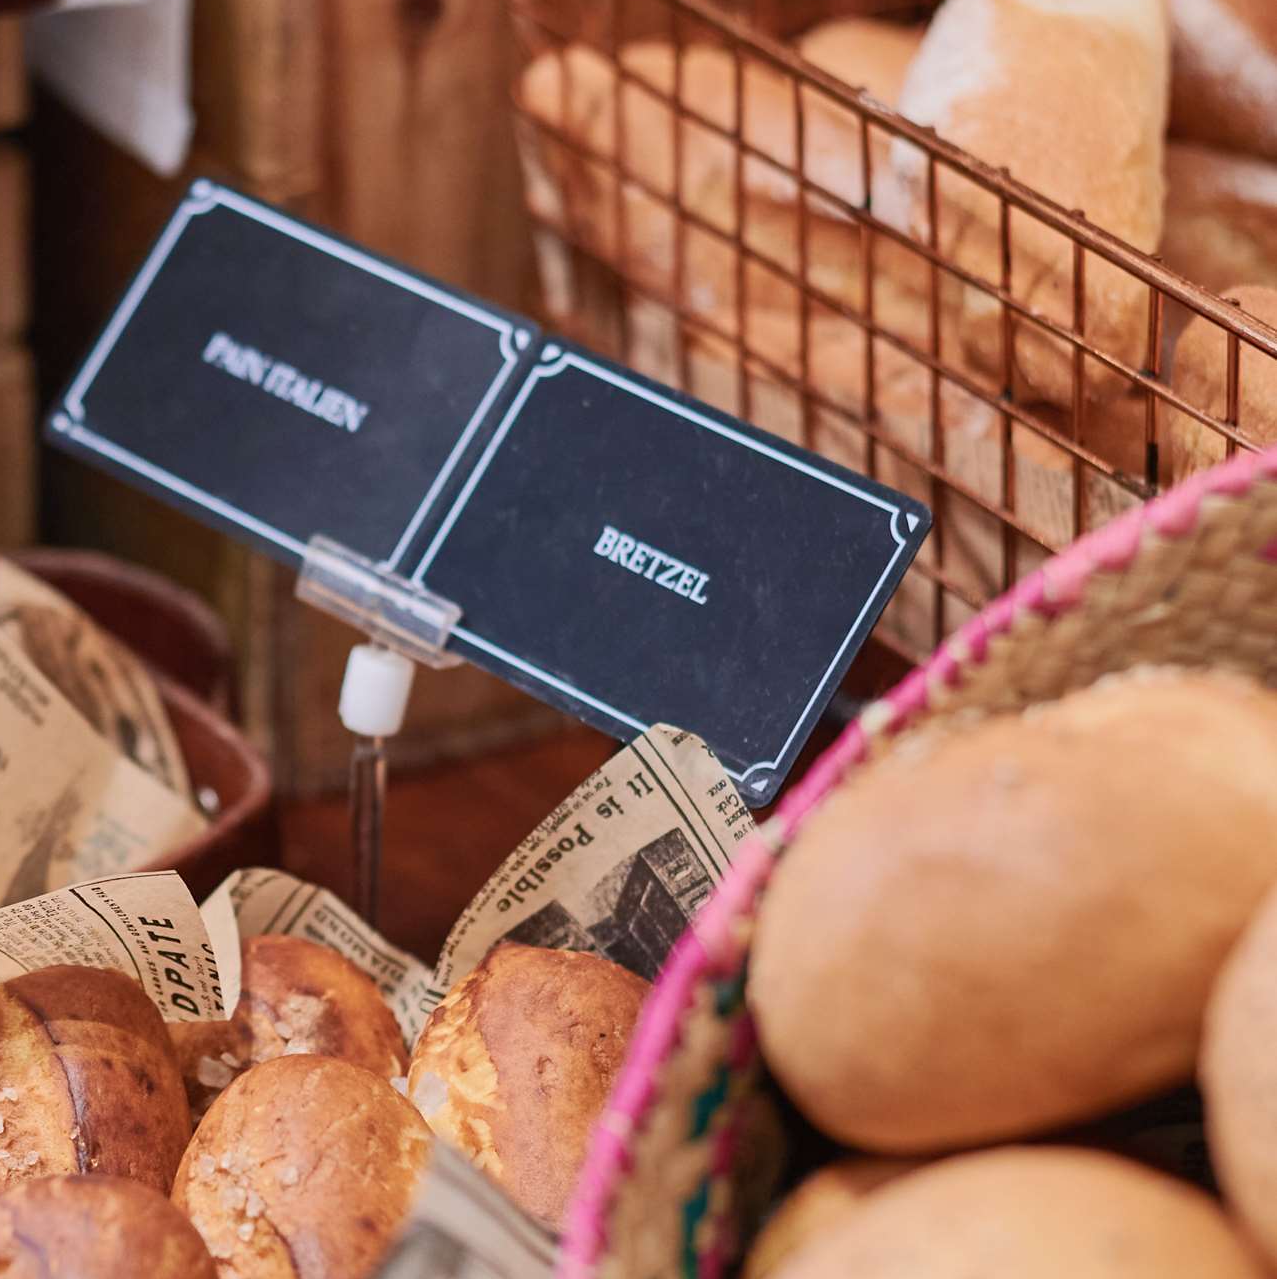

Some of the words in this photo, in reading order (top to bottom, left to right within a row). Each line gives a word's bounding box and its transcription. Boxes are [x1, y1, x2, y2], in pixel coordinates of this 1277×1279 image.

[593, 525, 709, 605] BRETZEL
[596, 789, 625, 819] is
[627, 772, 653, 798] It
[497, 823, 594, 912] Possible
